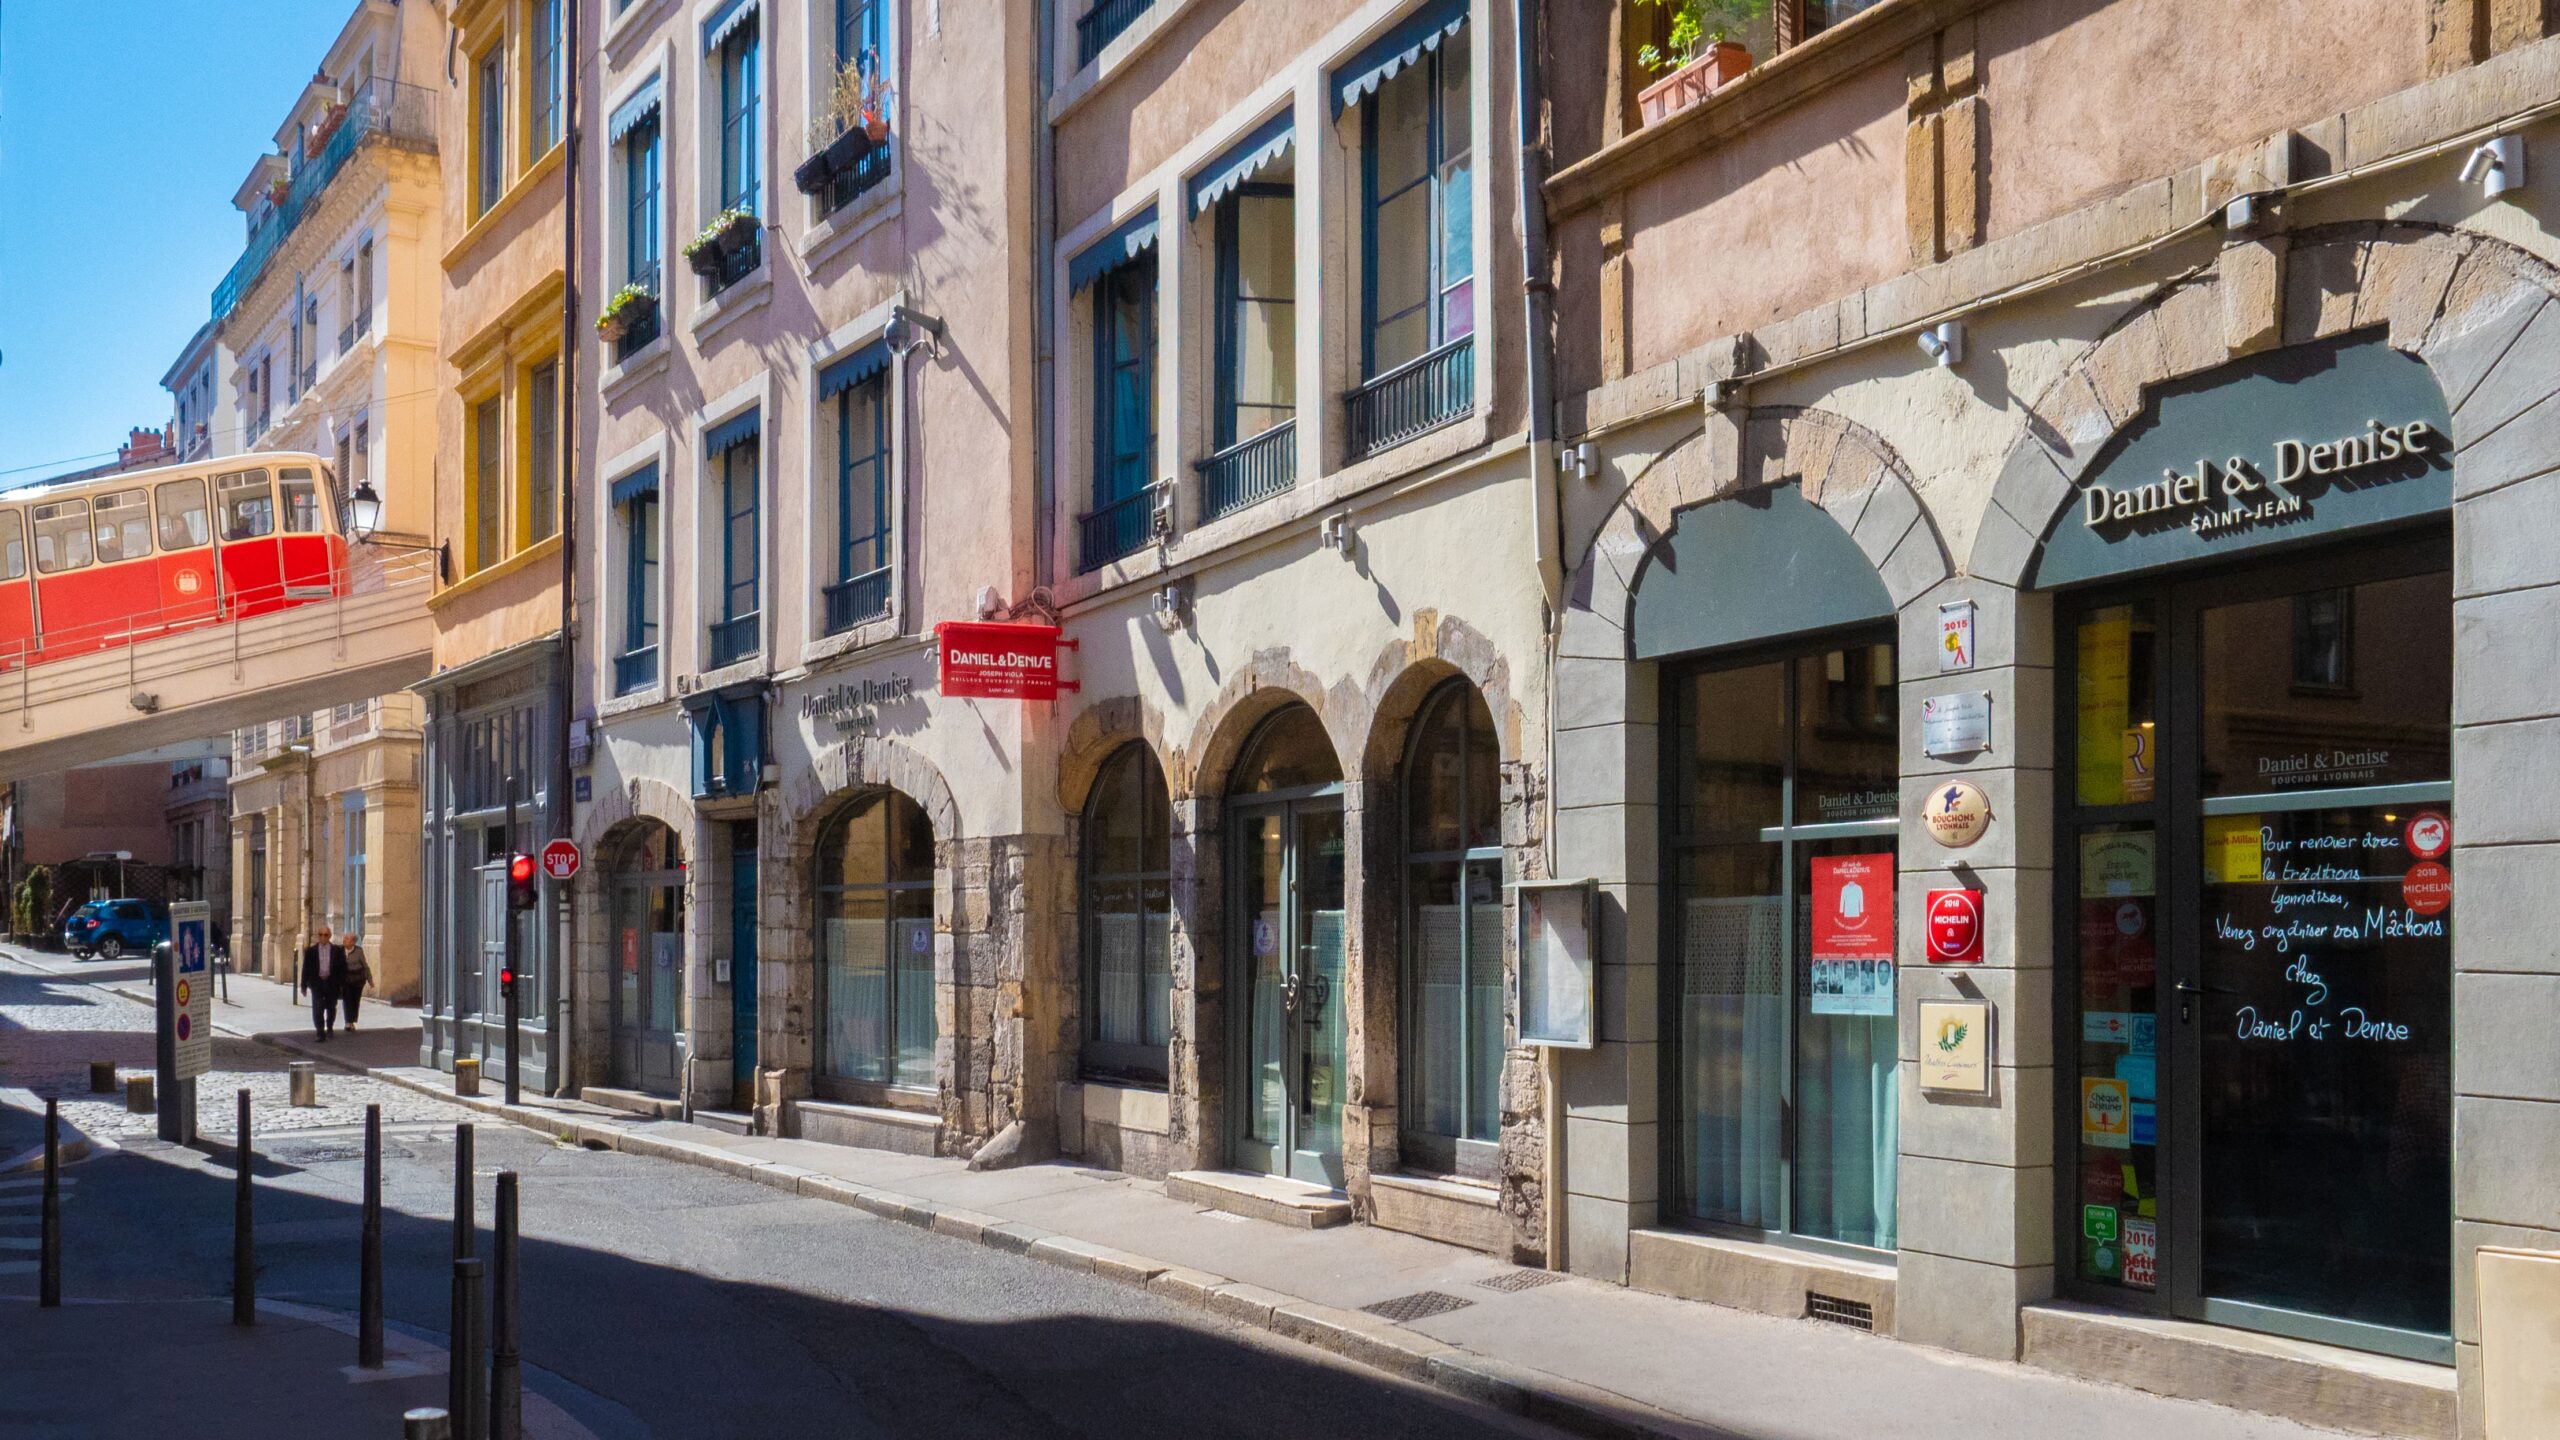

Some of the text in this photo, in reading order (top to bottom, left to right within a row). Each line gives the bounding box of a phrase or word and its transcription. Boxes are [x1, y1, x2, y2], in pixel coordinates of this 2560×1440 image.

[2082, 419, 2428, 527] Daniel & Denise
[2190, 496, 2301, 533] SAINT-JEAN
[1943, 619, 1968, 631] 2015
[979, 670, 1024, 679] JOSEPH VIOLA
[802, 671, 911, 719] Daniel & Denise
[2258, 748, 2389, 773] Daniel & Denise
[2271, 769, 2375, 785] BOUCHON LYONNAIS
[1819, 792, 1851, 808] Daniel
[1853, 793, 1863, 805] &
[1826, 806, 1893, 817] BOUCHON LYONNAIS
[1932, 813, 1976, 824] BOUCHONS
[1936, 822, 1970, 831] LYONNAIS
[2260, 826, 2292, 852] Pour
[2362, 831, 2400, 847] avec
[547, 853, 576, 865] STOP
[2282, 860, 2361, 881] traditions
[2416, 868, 2438, 877] 2018
[1934, 915, 1969, 925] MICHELIN
[2216, 906, 2443, 952] Venez organiser vos Mâchons
[2236, 1006, 2409, 1041] Daniel et Denise
[2091, 1092, 2121, 1104] Chèque
[2125, 1230, 2155, 1248] 2016
